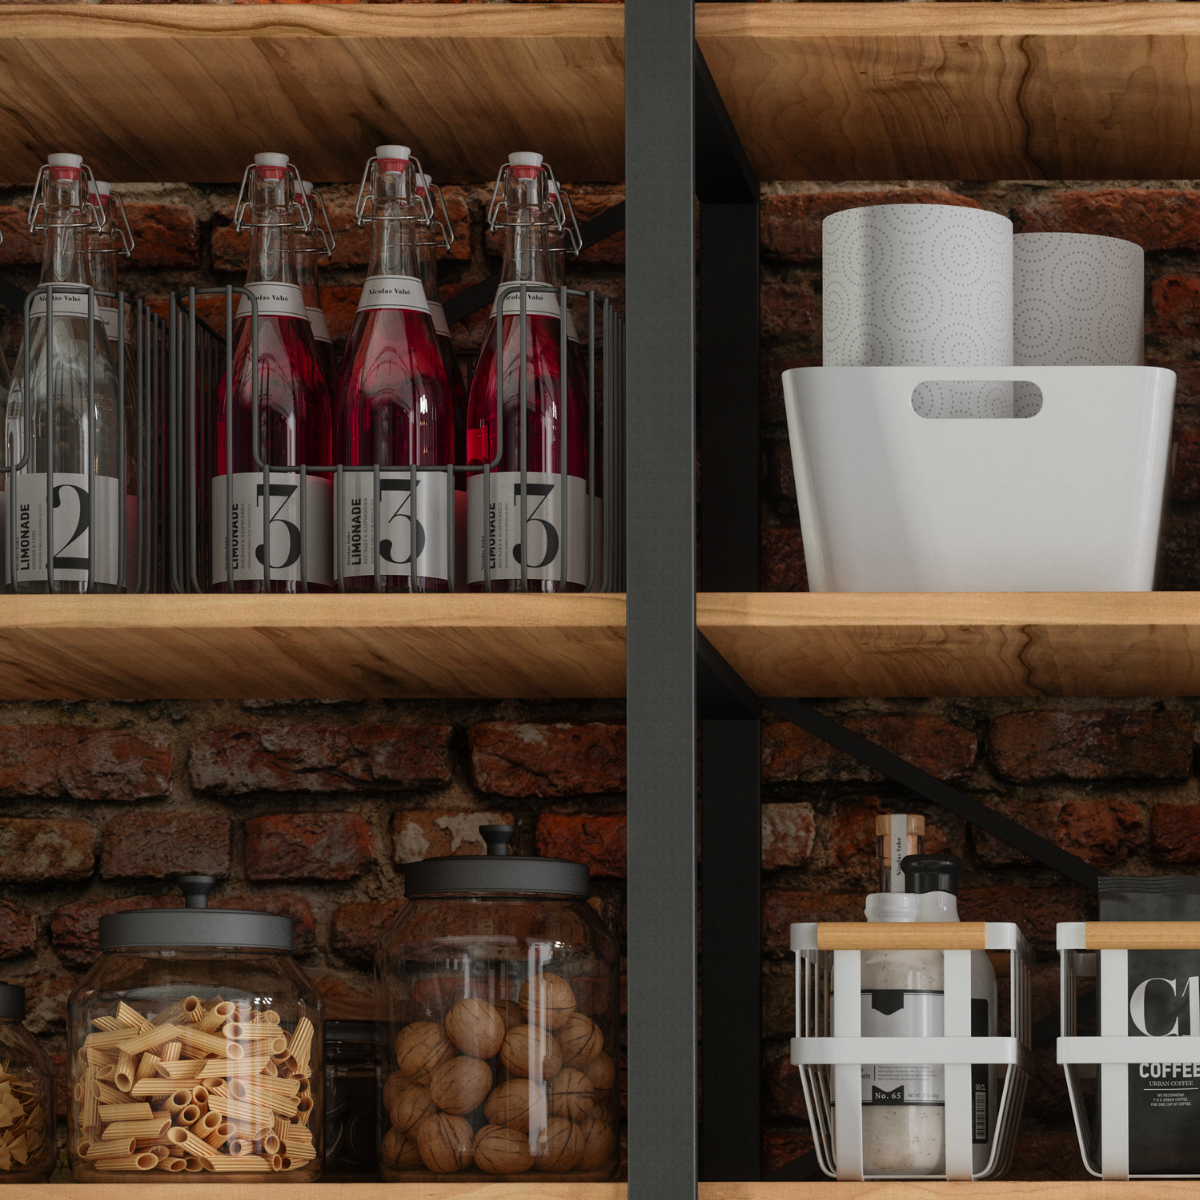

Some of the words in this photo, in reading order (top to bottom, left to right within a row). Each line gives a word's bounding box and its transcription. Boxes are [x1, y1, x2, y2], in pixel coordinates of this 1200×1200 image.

[20, 503, 30, 571] LIMONADE
[46, 484, 93, 569] 2
[255, 484, 302, 569] 3
[351, 498, 361, 566] LIMONADE
[379, 478, 426, 565] 3
[513, 483, 559, 569] 3
